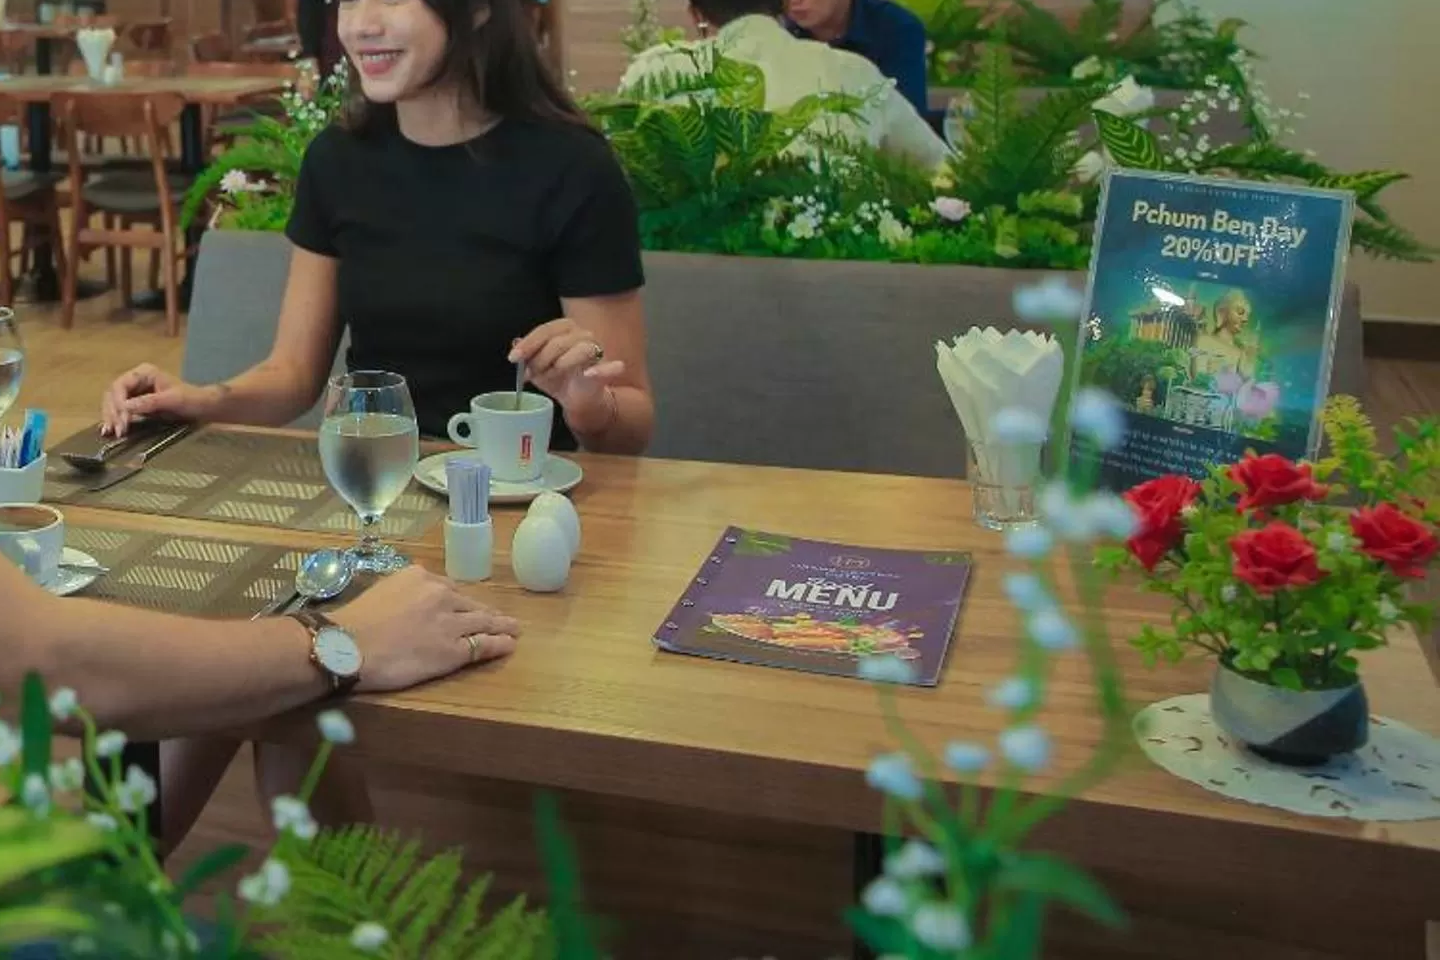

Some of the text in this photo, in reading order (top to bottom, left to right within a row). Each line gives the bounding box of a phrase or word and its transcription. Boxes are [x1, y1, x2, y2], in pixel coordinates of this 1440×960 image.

[1132, 200, 1307, 248] Pchum Ben Day
[765, 579, 899, 611] MENU
